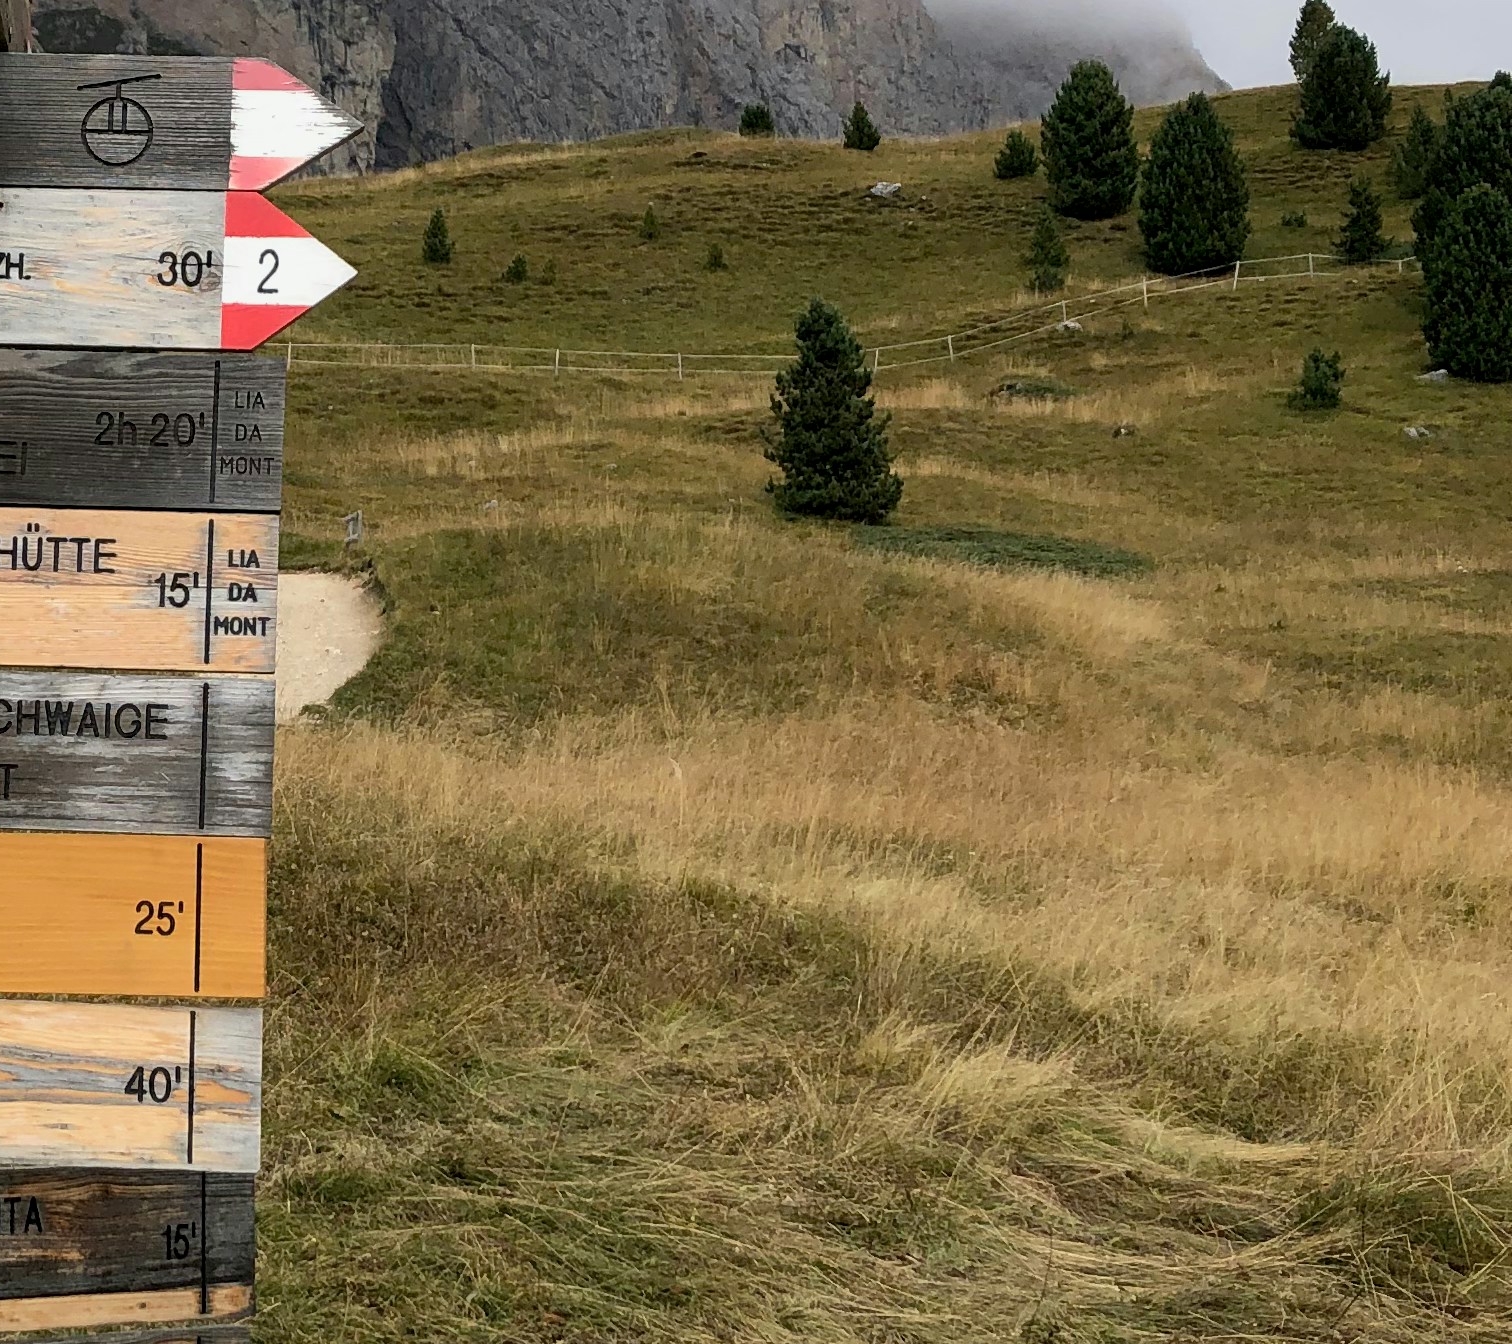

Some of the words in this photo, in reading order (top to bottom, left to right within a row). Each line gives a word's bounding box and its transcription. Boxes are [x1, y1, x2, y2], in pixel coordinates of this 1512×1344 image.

[258, 250, 280, 294] 2
[234, 390, 265, 410] LIA
[94, 411, 138, 446] 2h
[235, 424, 261, 442] DA
[219, 455, 273, 476] MONT
[228, 549, 260, 568] LIA
[228, 584, 257, 602] DA
[214, 615, 270, 637] MONT
